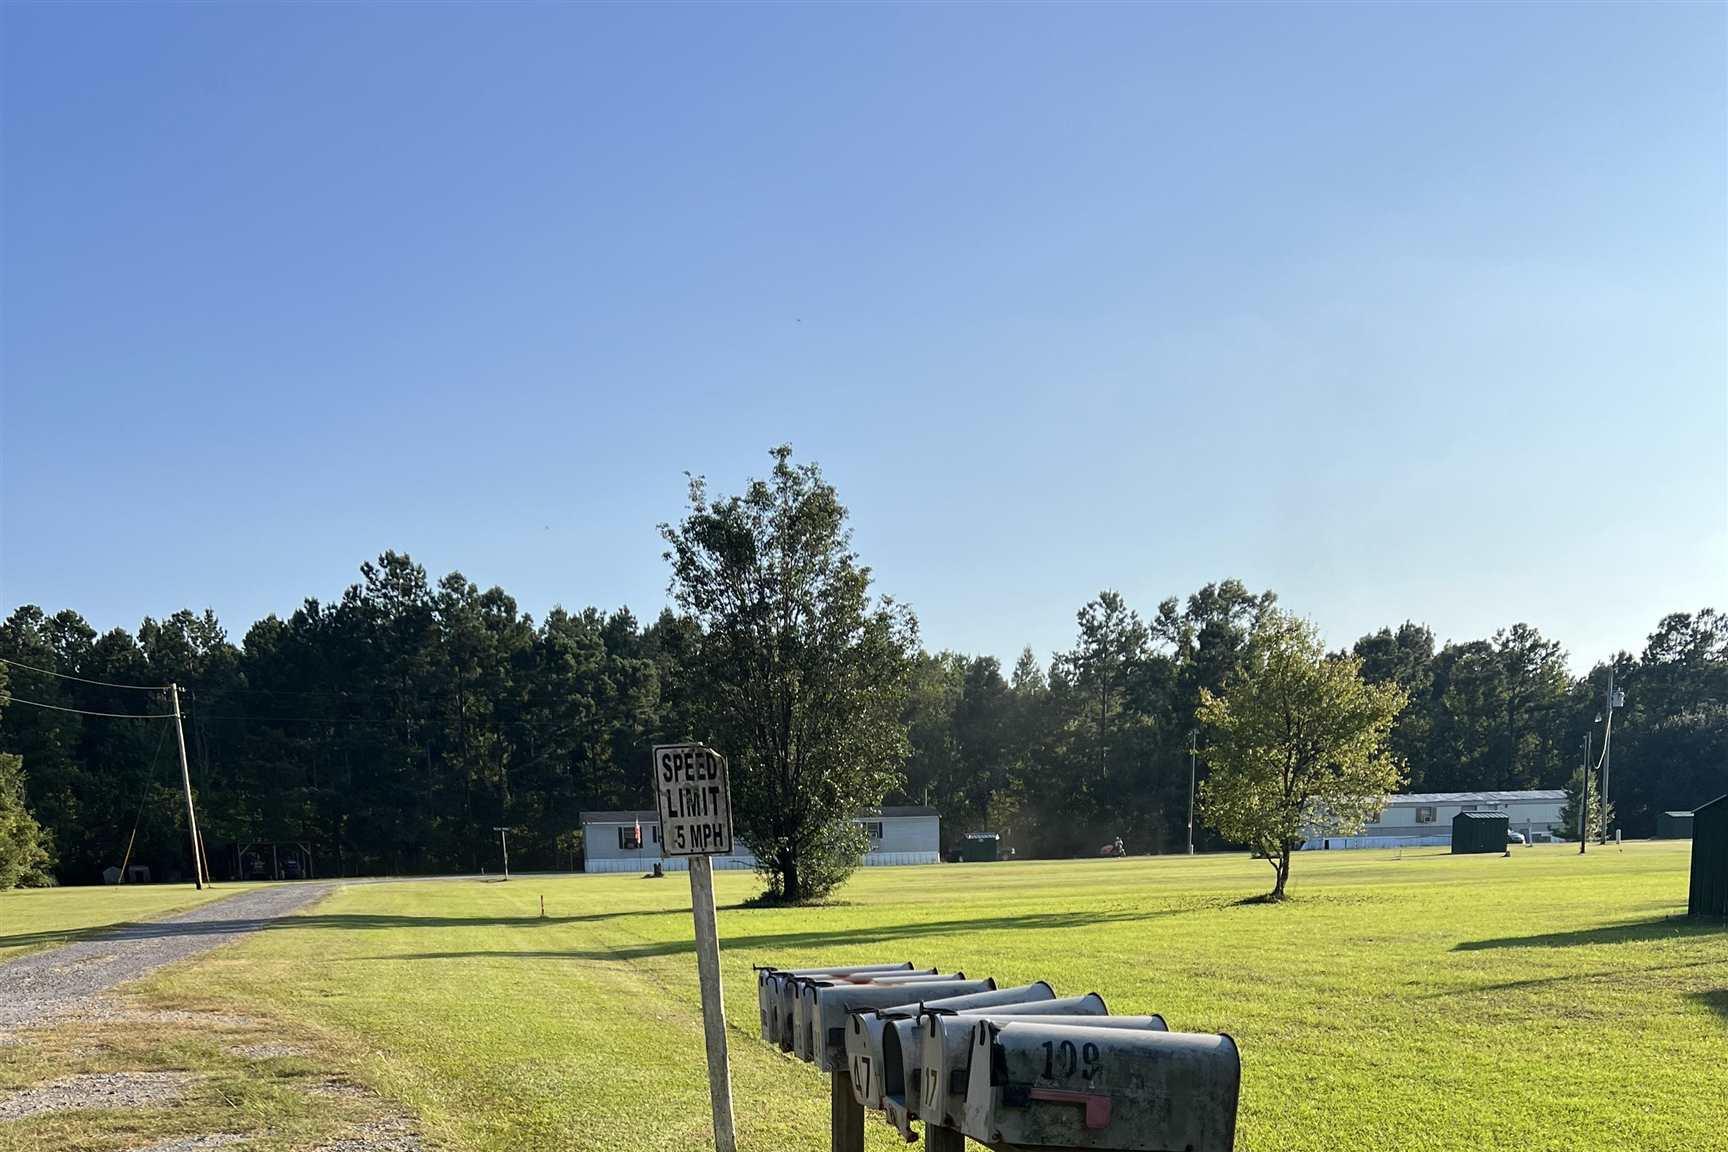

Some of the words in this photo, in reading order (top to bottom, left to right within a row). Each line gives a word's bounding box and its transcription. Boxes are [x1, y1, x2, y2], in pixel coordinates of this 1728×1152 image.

[662, 752, 718, 783] SPEED
[666, 786, 720, 818] LIMIT
[689, 823, 724, 849] MPH
[1041, 1040, 1103, 1081] 109
[925, 1067, 938, 1107] 17
